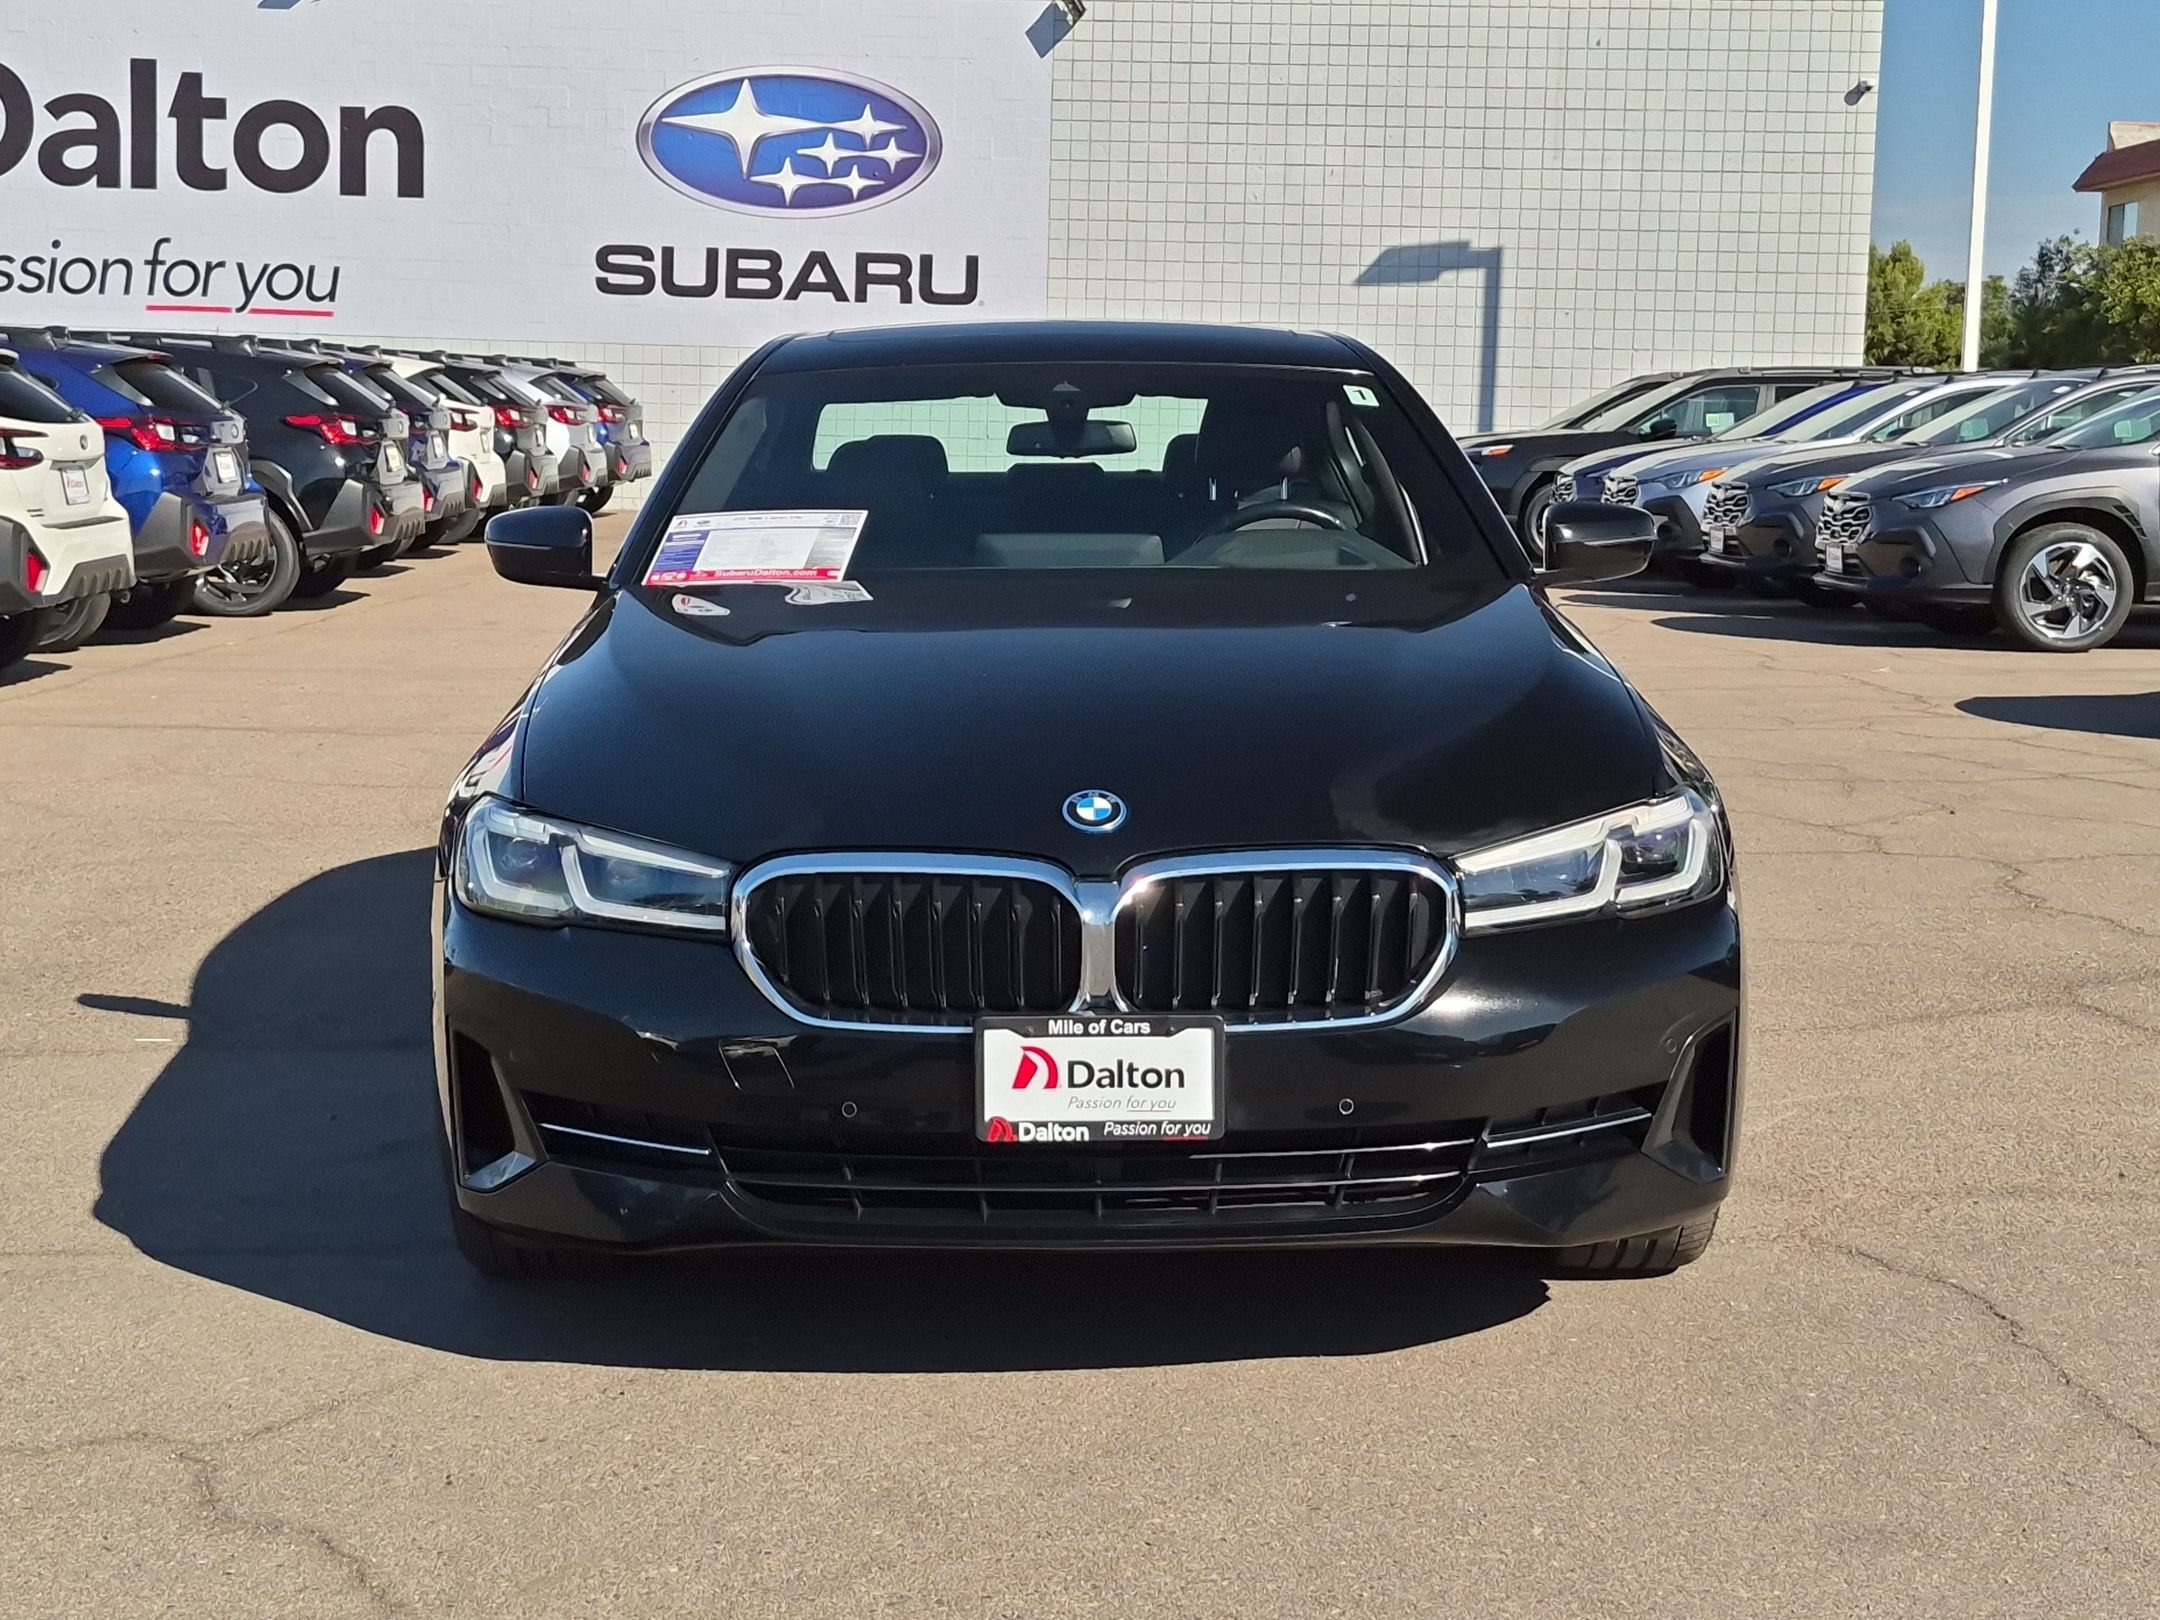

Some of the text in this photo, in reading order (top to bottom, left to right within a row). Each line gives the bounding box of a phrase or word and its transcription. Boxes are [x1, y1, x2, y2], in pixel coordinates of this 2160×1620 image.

[144, 237, 226, 297] for
[234, 258, 340, 314] you
[595, 244, 979, 305] SUBARU
[1048, 1019, 1151, 1035] Mile of Cars
[1067, 1059, 1185, 1089] Dalton
[1067, 1095, 1177, 1112] Passion for you
[1018, 1122, 1089, 1142] Dalton
[1103, 1120, 1211, 1139] Passion for you
